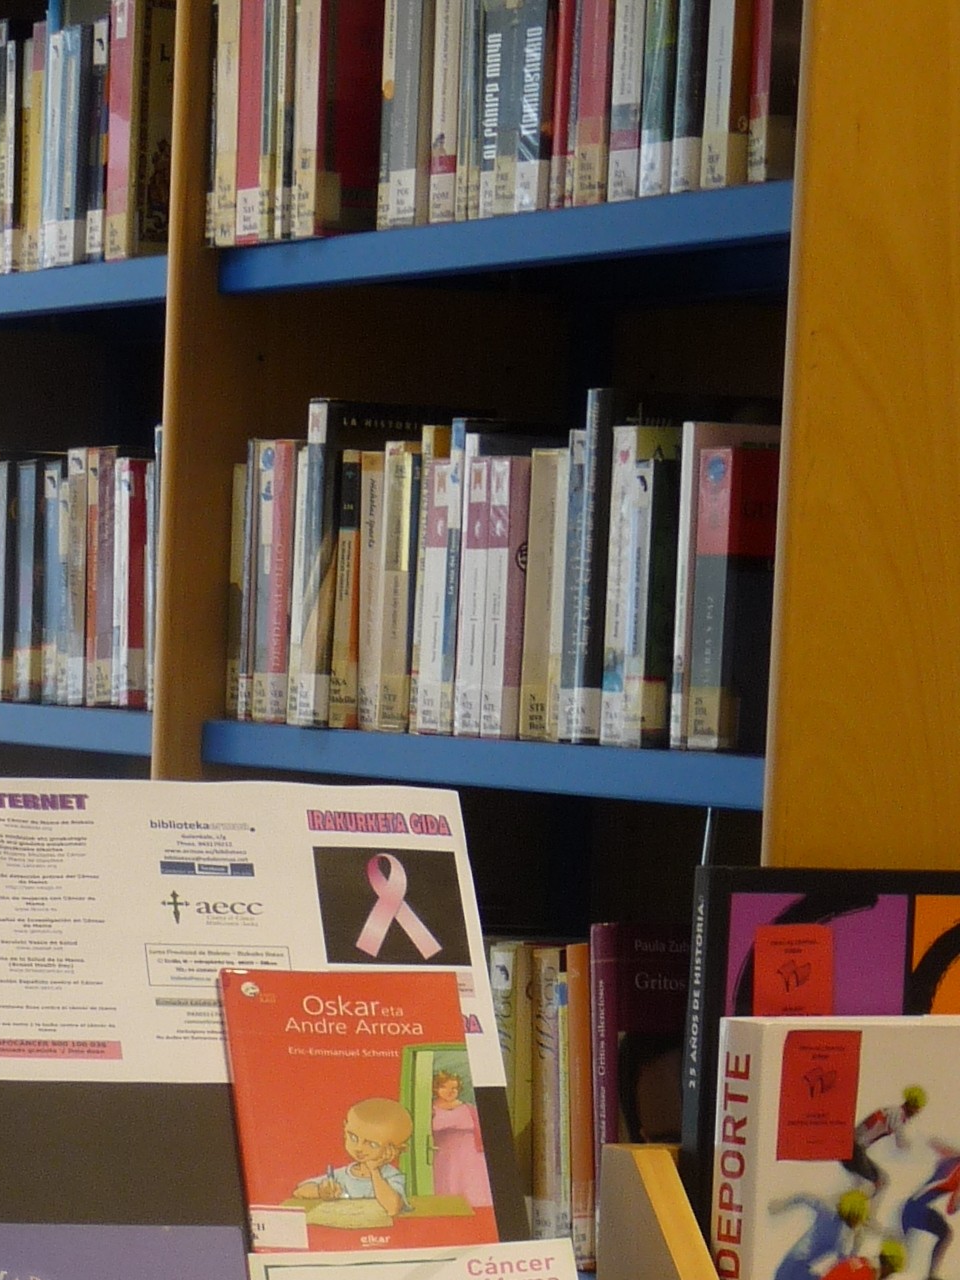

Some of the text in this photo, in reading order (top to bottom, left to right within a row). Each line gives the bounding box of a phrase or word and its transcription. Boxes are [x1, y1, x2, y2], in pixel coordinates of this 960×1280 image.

[306, 809, 453, 837] IRAKURKETA GIDA
[195, 900, 264, 916] aecc
[633, 938, 667, 954] Paula
[693, 902, 705, 985] HISTORIA
[634, 971, 686, 992] Gritos
[302, 994, 405, 1017] Oskar eta
[597, 978, 606, 1038] silenciosos
[691, 988, 702, 1012] DE
[284, 1017, 425, 1036] Andre Arroxa
[688, 1014, 700, 1062] AÑOS
[288, 1046, 400, 1059] Eric-Emmanuel Schmitt
[597, 1040, 606, 1076] Gritos
[715, 1051, 752, 1279] DEPORTE
[360, 1233, 392, 1246] elkar
[466, 1254, 556, 1277] Cáncer
